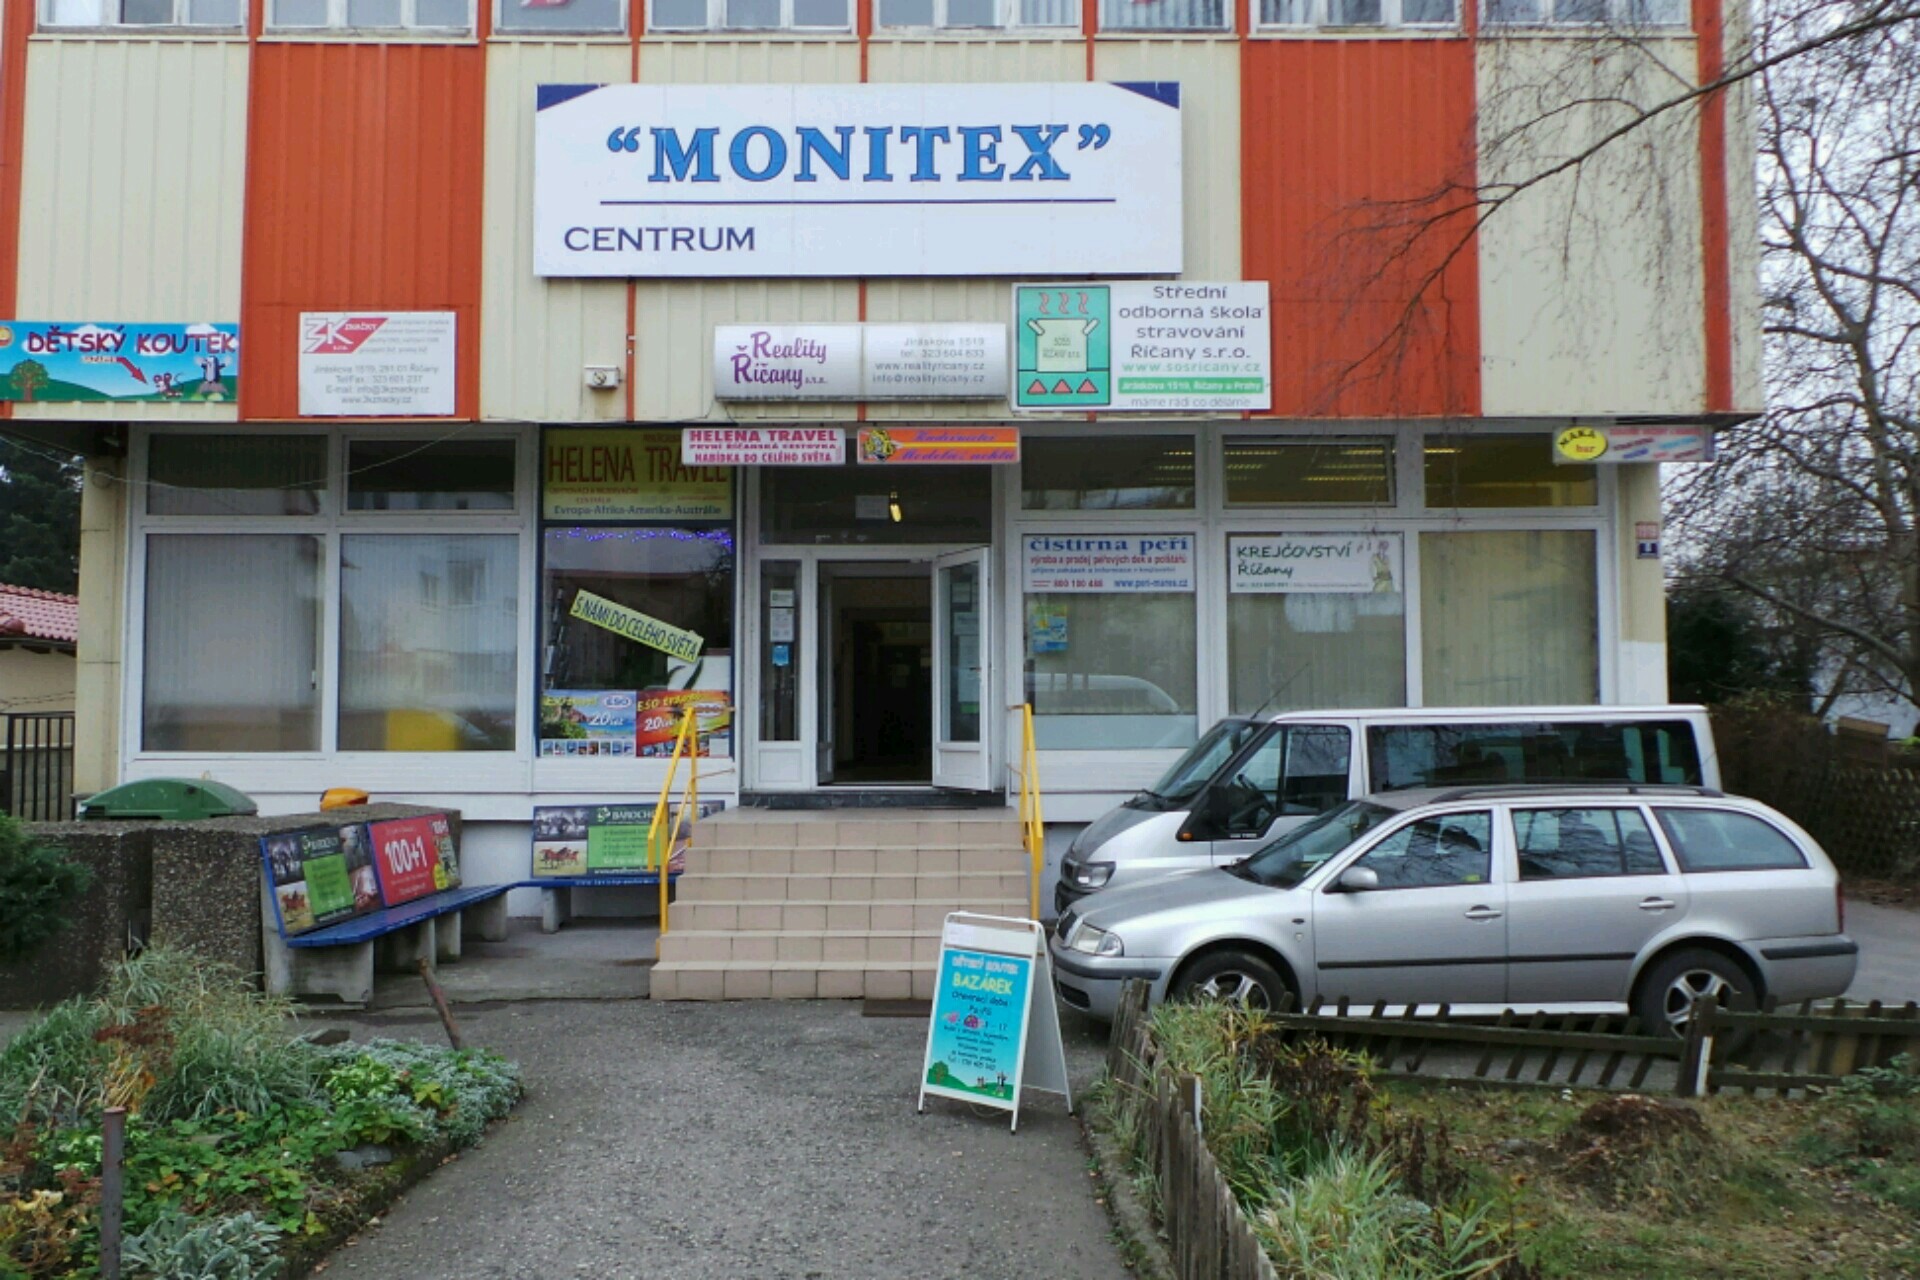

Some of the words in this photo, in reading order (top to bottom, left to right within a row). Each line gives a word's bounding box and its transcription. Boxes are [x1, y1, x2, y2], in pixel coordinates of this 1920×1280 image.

[563, 226, 756, 252] CENTRUM
[1153, 286, 1227, 300] Střední
[1119, 305, 1203, 319] odborná
[1210, 305, 1262, 319] škola
[28, 325, 127, 353] DĚTSKÝ
[136, 333, 236, 354] KOUTEK
[1136, 325, 1245, 339] stravování
[750, 330, 827, 364] Reality
[1131, 345, 1196, 361] Říčany
[1202, 347, 1251, 359] s.r.o.
[730, 345, 804, 389] Říčany
[1121, 362, 1261, 374] www.sosricany.cz
[689, 430, 761, 442] HELENA
[767, 430, 837, 442] TRAVEL
[549, 446, 635, 482] HELENA
[695, 451, 740, 463] NABÍDKA
[744, 453, 757, 463] DO
[762, 450, 799, 463] CELÉHO
[801, 450, 831, 463] SVĚTA
[1139, 537, 1188, 556] peří
[1236, 541, 1352, 558] KREJČOVSTVÍ
[572, 596, 583, 613] S
[582, 598, 611, 625] NÁMI
[607, 609, 626, 631] DO
[625, 618, 667, 647] CELÉHO
[666, 632, 698, 658] SVĚTA
[384, 835, 428, 876] 100+1
[952, 971, 1014, 995] BAZÁREK
